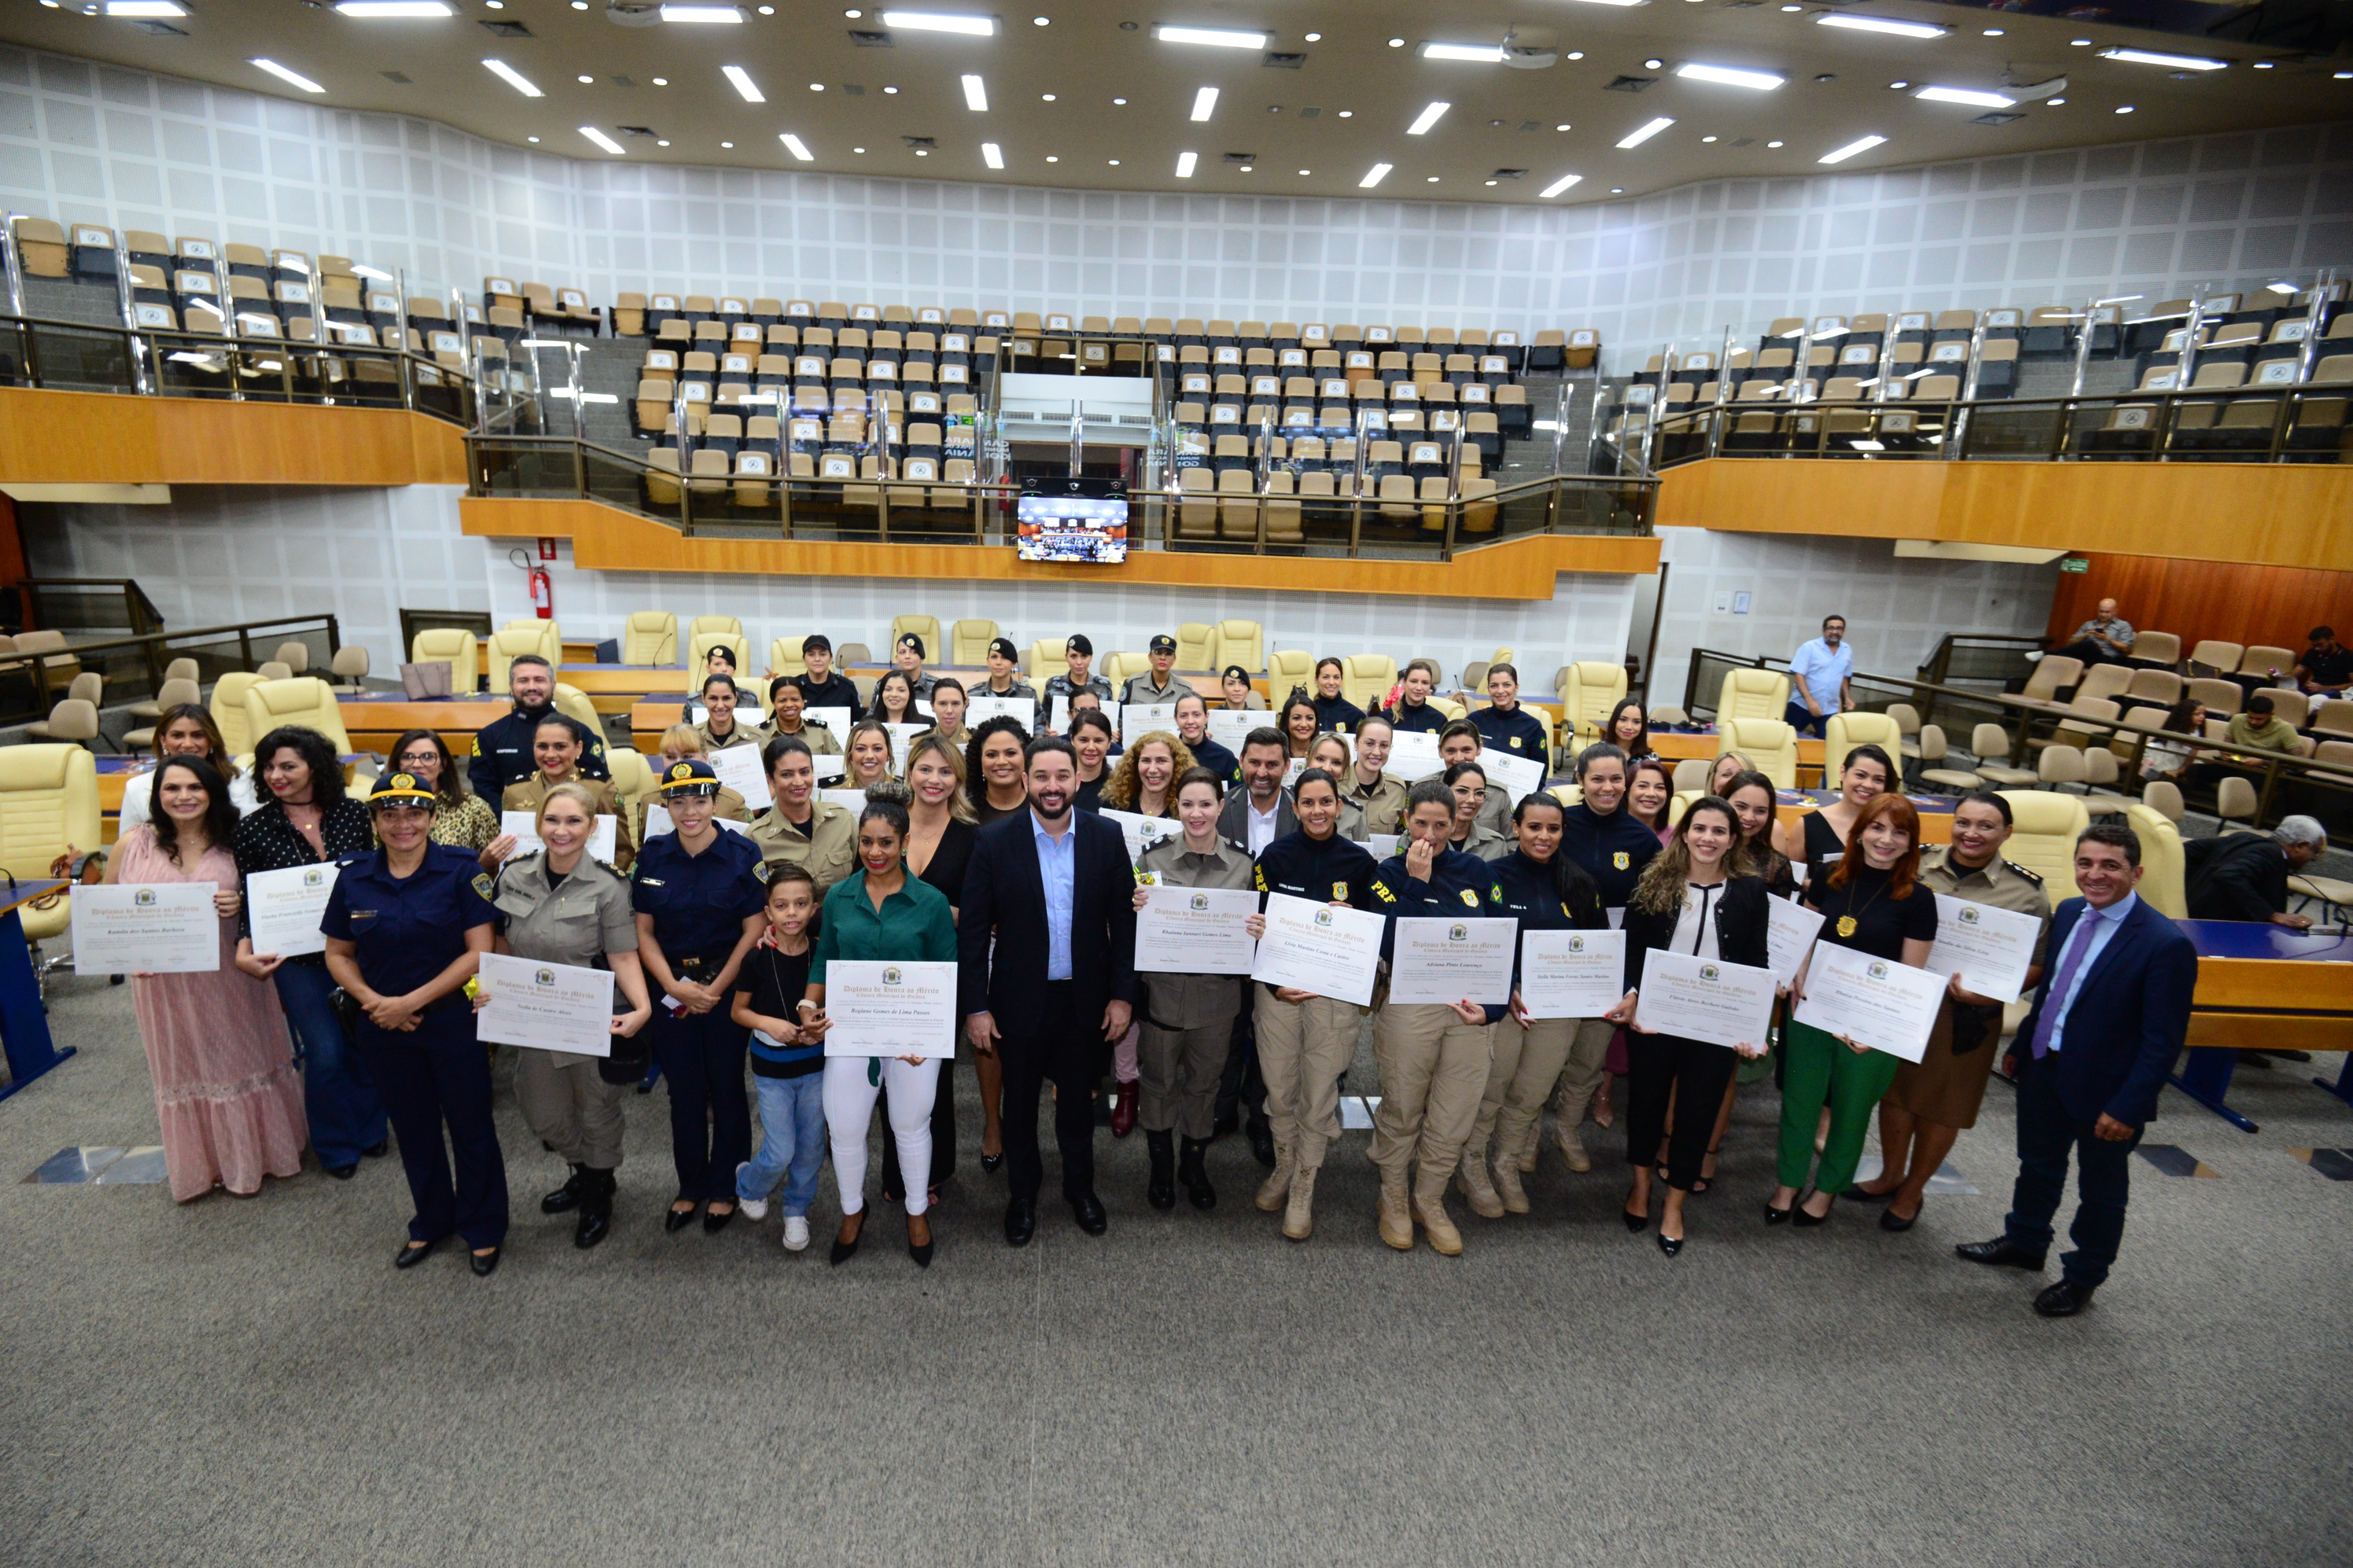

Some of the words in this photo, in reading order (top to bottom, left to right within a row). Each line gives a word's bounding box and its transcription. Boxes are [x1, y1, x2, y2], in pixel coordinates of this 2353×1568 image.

[1255, 864, 1268, 891] PRF
[1371, 880, 1396, 903] PRF
[1280, 917, 1304, 930] Diploma
[1314, 926, 1333, 936] Honra
[1344, 932, 1365, 943] Mérito
[1298, 944, 1315, 953] Martins
[497, 979, 525, 990] Diploma
[537, 986, 559, 995] Honra
[571, 990, 594, 999] Mérito
[1660, 973, 1688, 983] Diploma
[1699, 979, 1721, 990] Honra
[1733, 985, 1757, 995] Mérito
[1883, 1004, 1900, 1014] Santos
